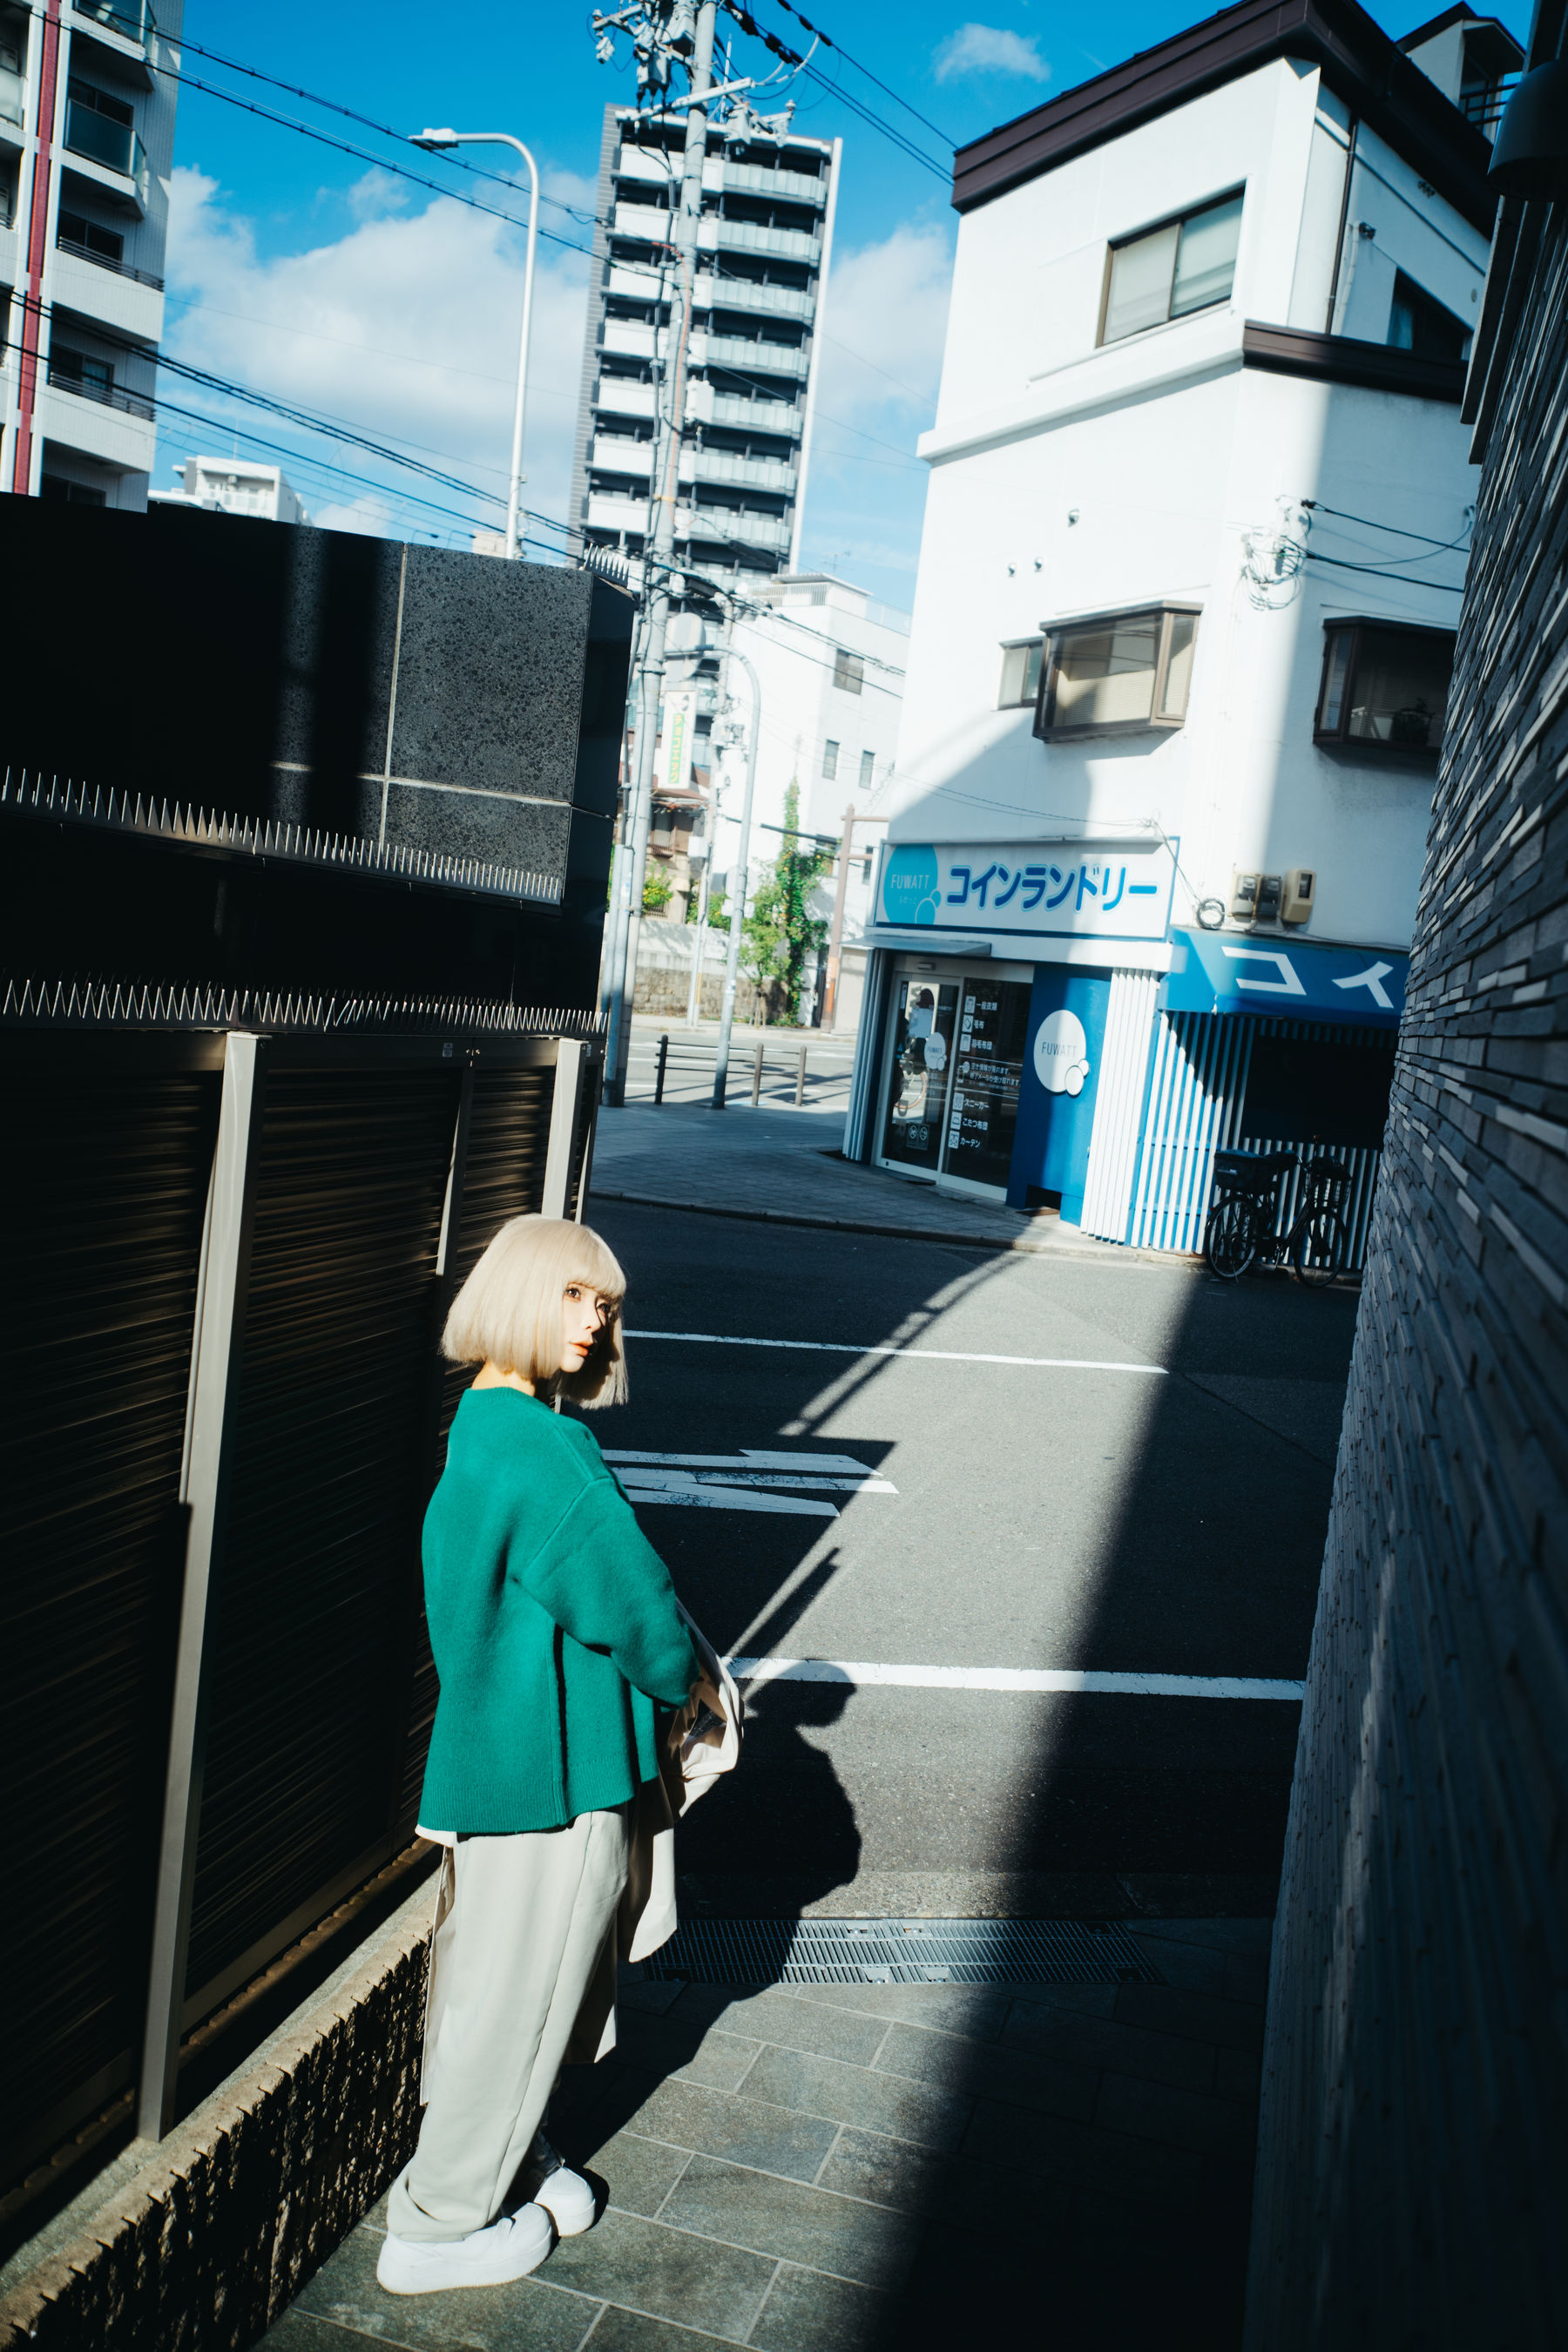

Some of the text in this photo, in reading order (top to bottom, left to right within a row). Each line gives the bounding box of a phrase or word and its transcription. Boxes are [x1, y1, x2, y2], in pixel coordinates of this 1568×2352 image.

[890, 874, 930, 889] FUWATT
[946, 863, 1159, 912] コインランドリー
[973, 1019, 984, 1029] 毛布
[1041, 1042, 1078, 1057] FUWATT
[963, 1098, 990, 1110] スニーカー
[962, 1118, 988, 1131] こたつ布団
[960, 1137, 981, 1148] カーテン
